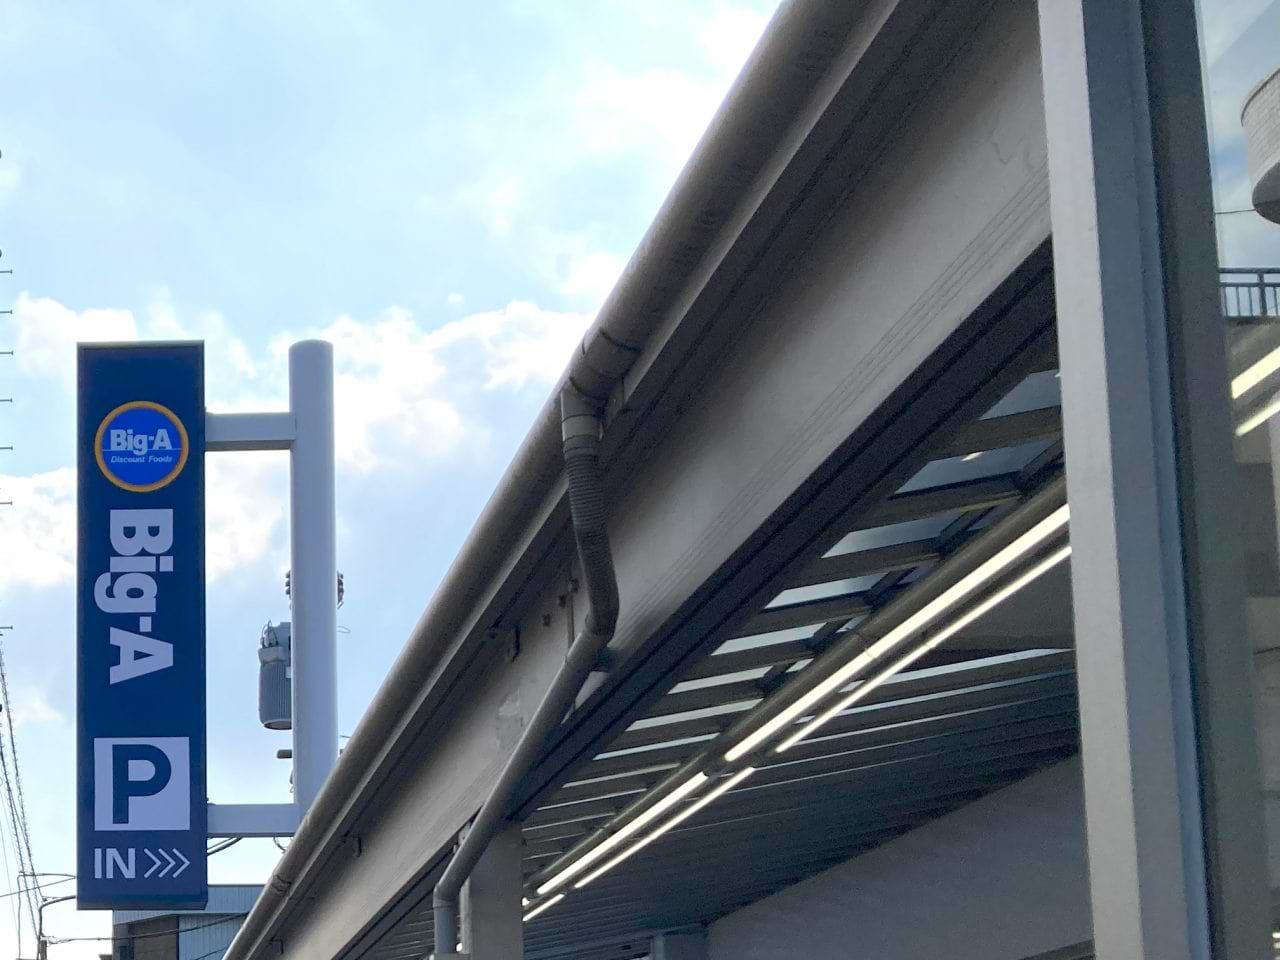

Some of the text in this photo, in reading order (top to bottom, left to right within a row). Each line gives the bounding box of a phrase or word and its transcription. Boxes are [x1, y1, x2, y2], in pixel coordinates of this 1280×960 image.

[110, 429, 173, 455] Big-A
[111, 455, 173, 463] Discount Foods
[94, 508, 175, 685] Big-A
[112, 744, 172, 824] P
[94, 848, 136, 879] IN
